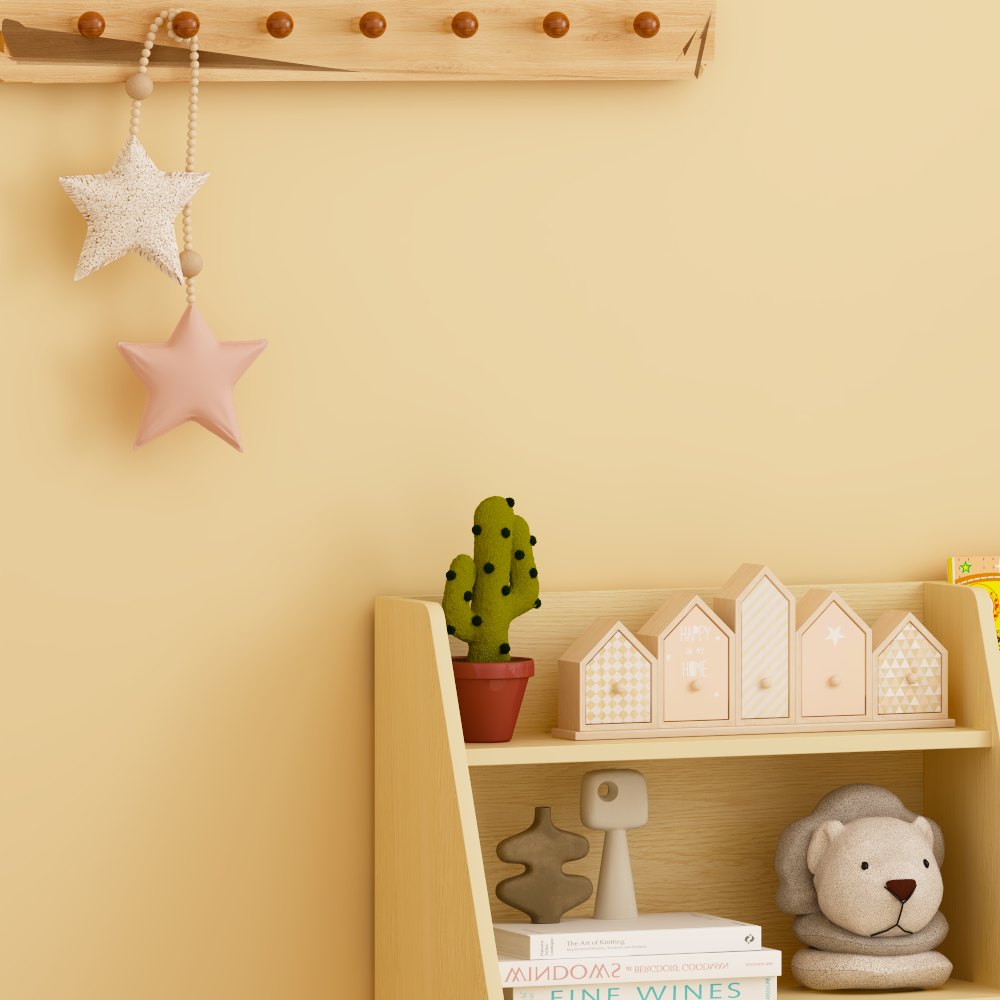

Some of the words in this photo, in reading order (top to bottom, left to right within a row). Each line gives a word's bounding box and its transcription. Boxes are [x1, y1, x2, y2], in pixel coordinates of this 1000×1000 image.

[680, 625, 711, 642] HAPPY
[682, 660, 708, 678] HOME
[600, 938, 626, 946] Knitting
